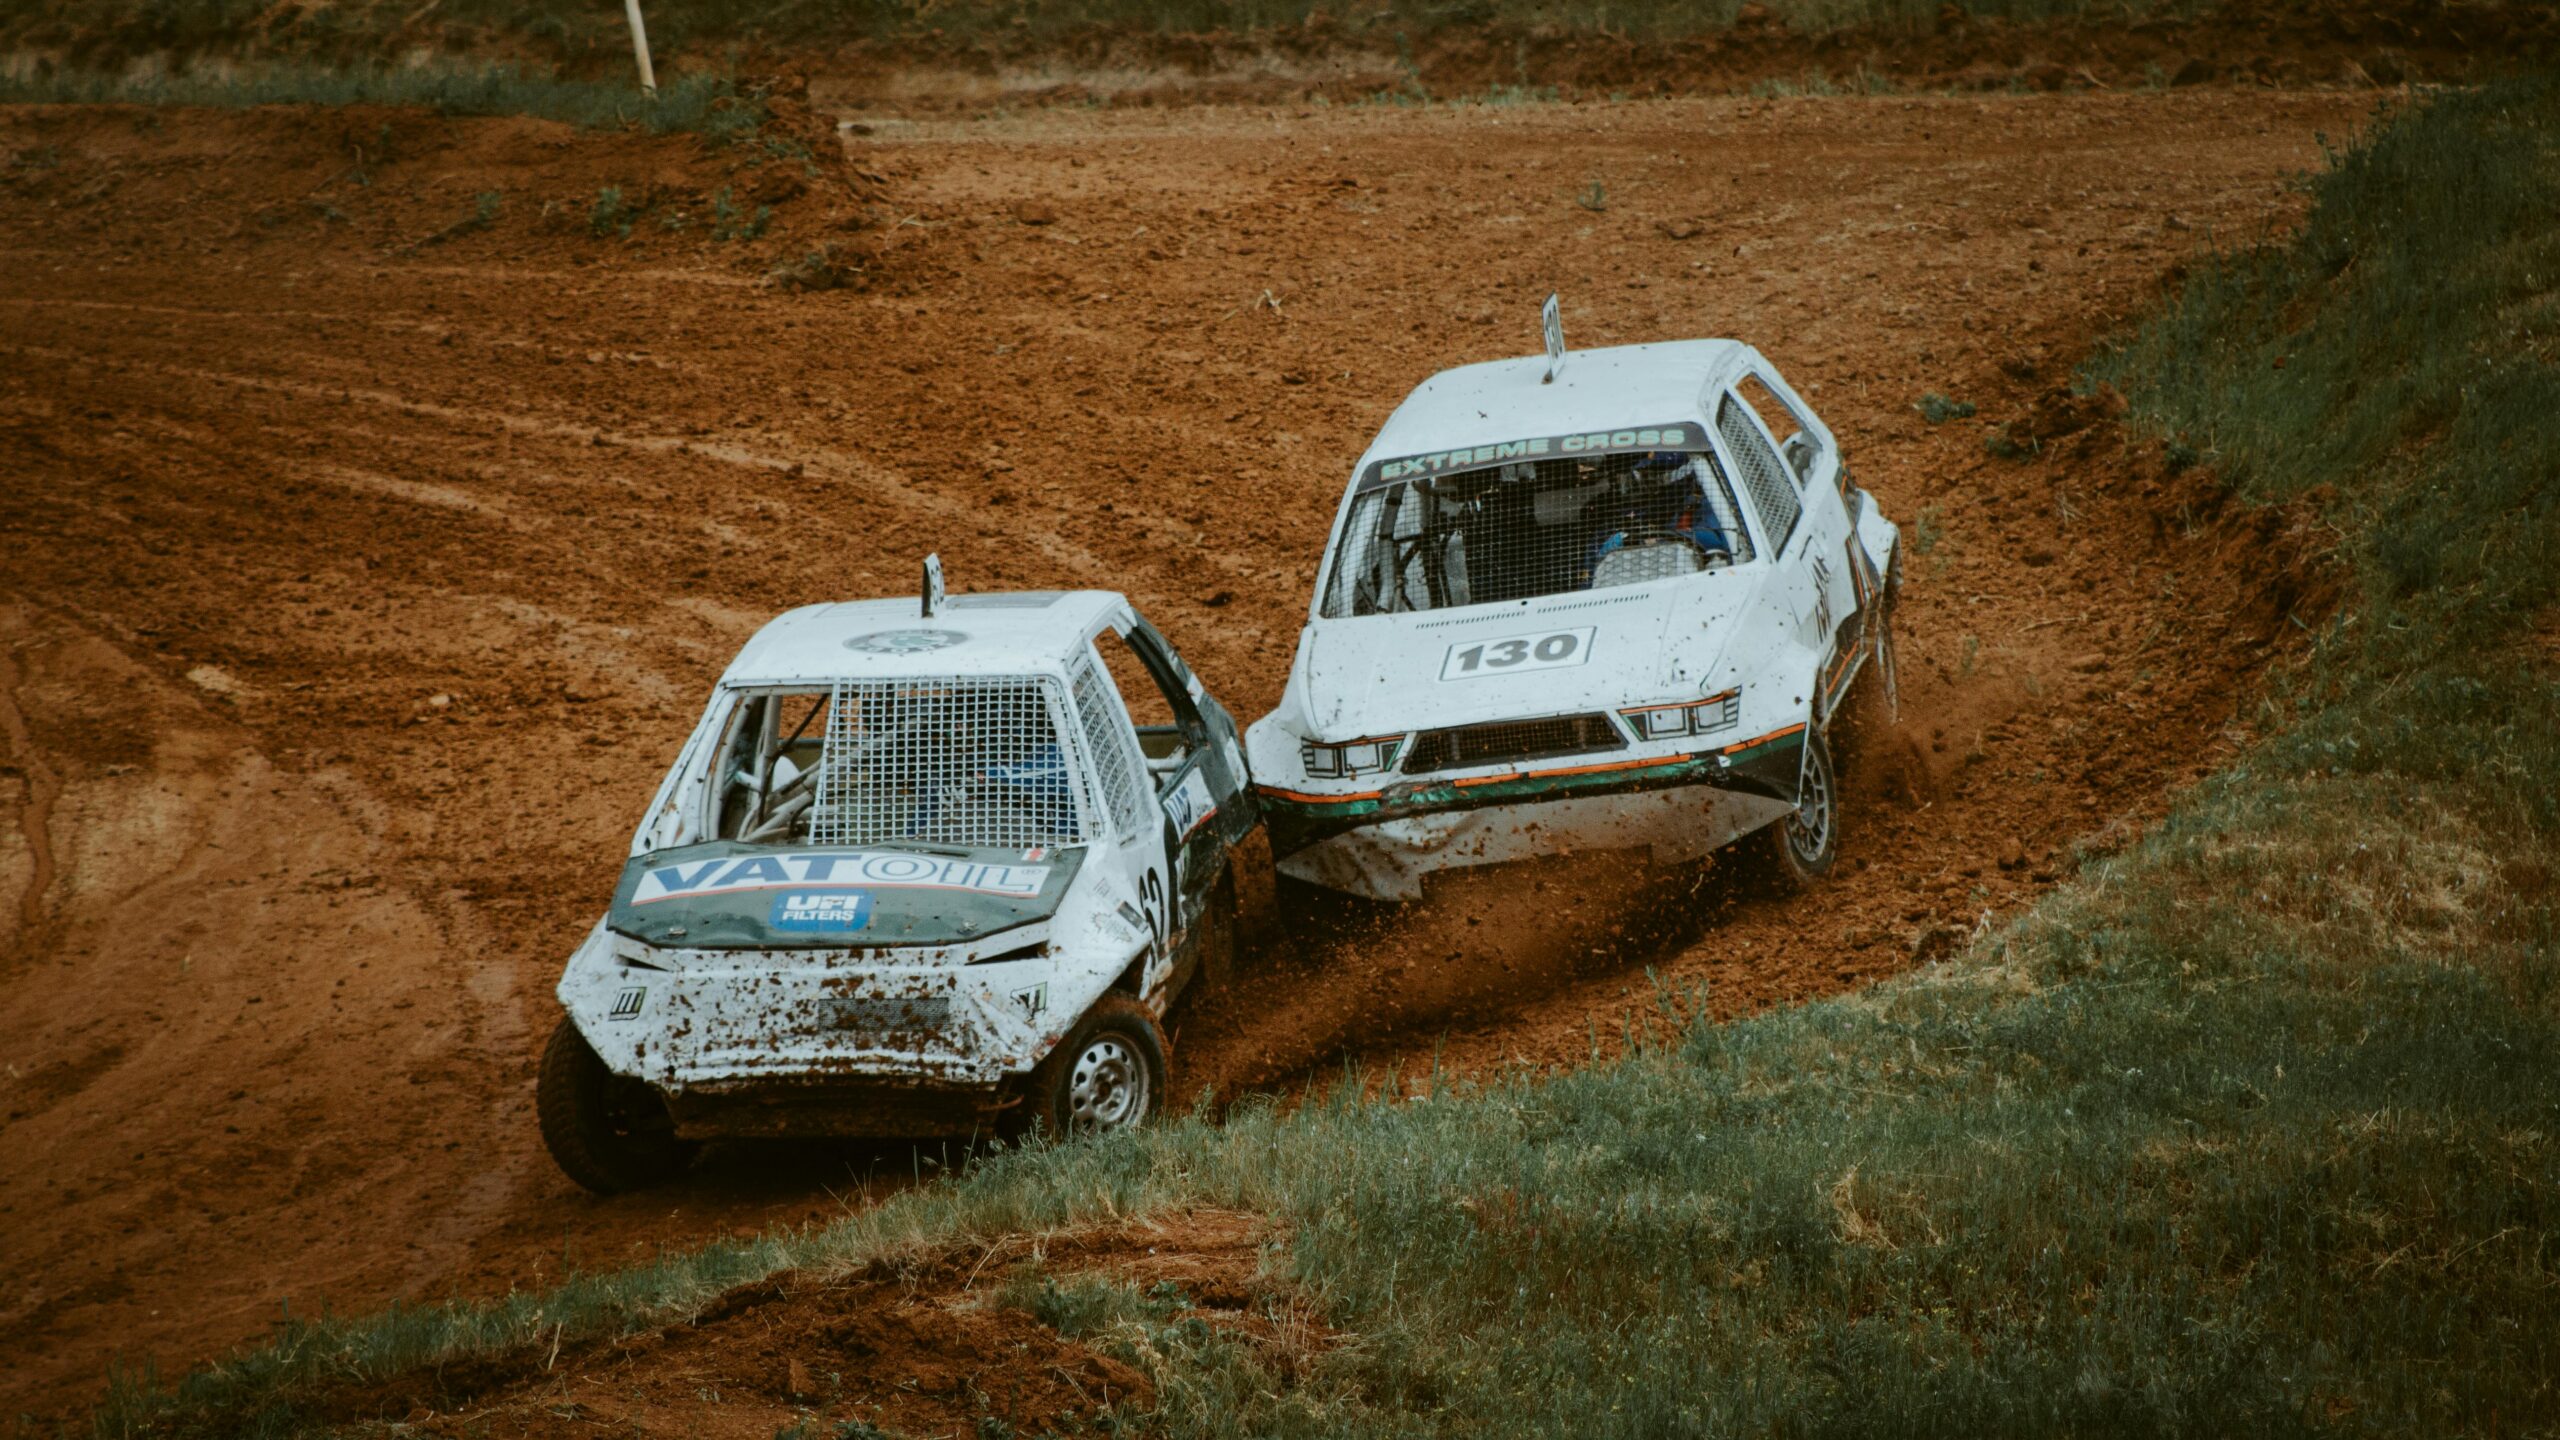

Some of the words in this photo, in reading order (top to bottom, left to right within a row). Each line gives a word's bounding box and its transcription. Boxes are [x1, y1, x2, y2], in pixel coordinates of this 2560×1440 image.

[1380, 438, 1550, 481] EXTREME
[1561, 429, 1686, 452] CROSS
[1456, 633, 1579, 672] 130
[653, 853, 1034, 892] VATOIL
[781, 909, 855, 921] FILTERS
[785, 895, 860, 911] UFI
